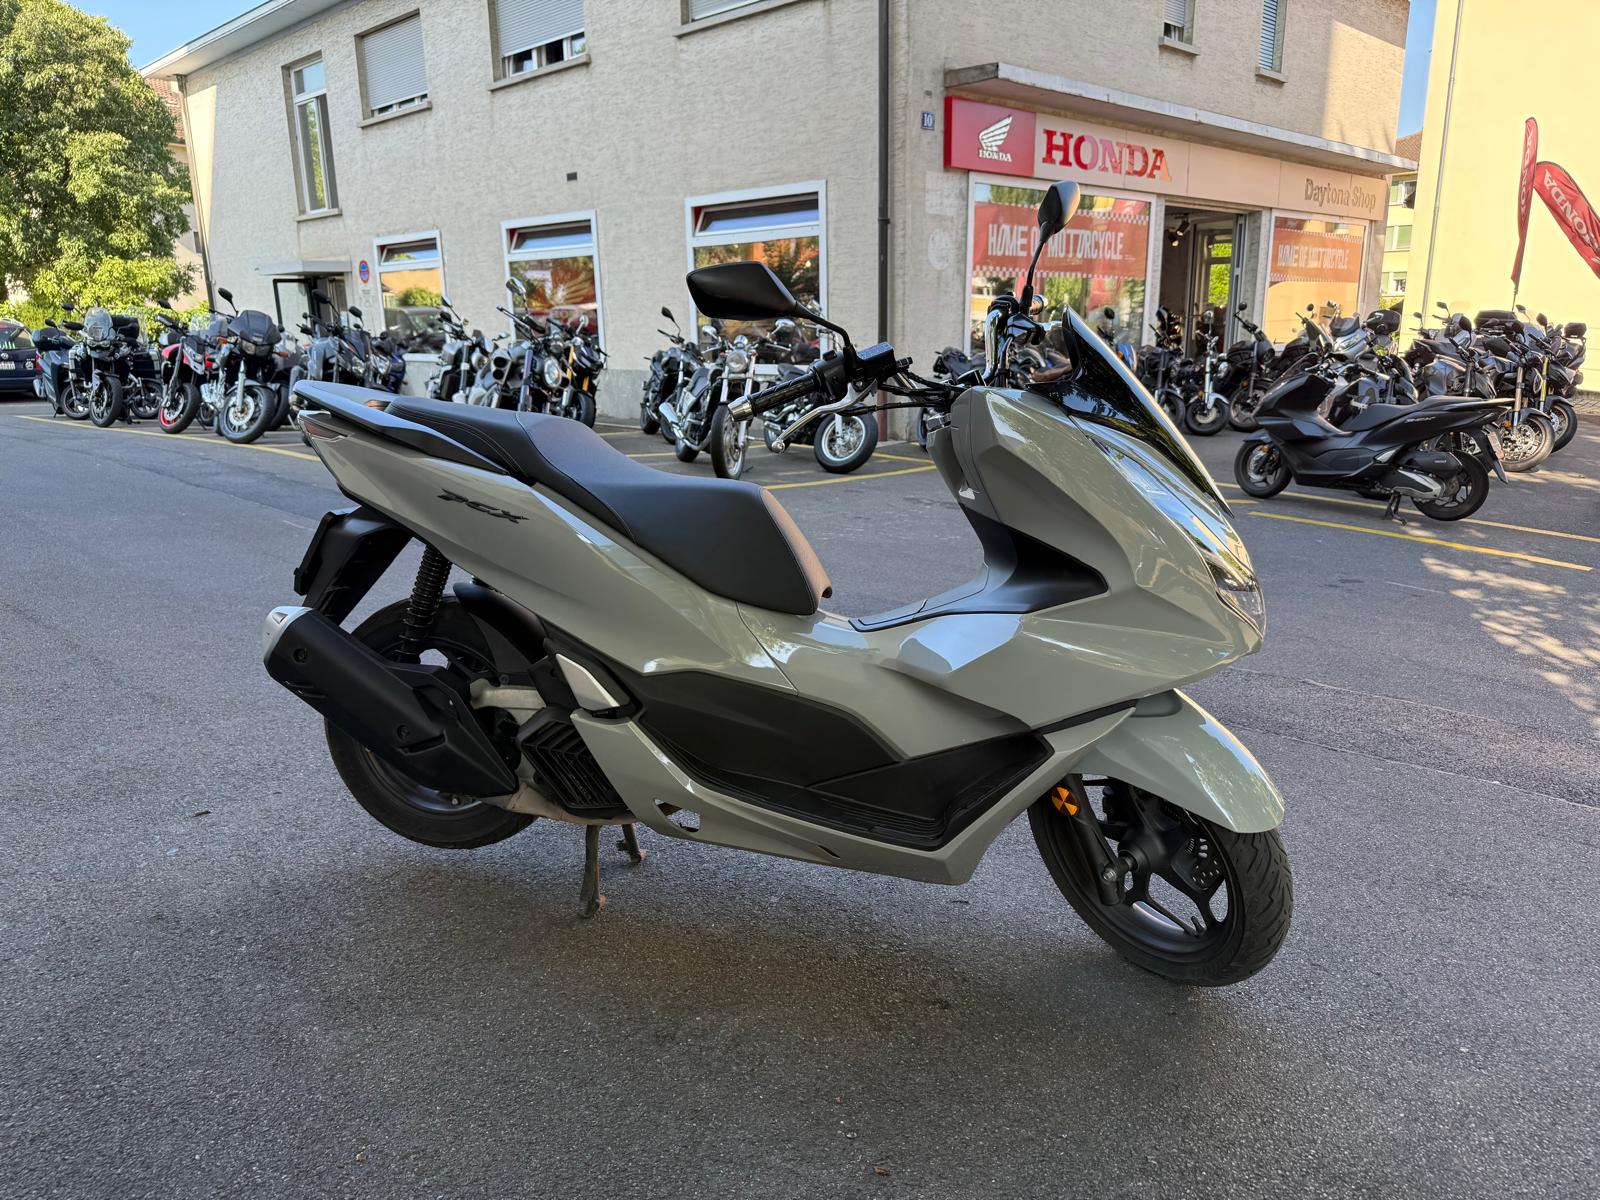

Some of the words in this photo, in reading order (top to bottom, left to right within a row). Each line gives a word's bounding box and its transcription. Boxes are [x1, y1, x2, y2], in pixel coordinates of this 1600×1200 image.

[923, 113, 933, 128] 10
[979, 149, 1013, 163] HONDA
[1042, 128, 1173, 182] HONDA
[1304, 178, 1351, 207] Daytona
[1352, 185, 1377, 213] Shop
[1030, 226, 1043, 258] O
[437, 488, 530, 525] PCX
